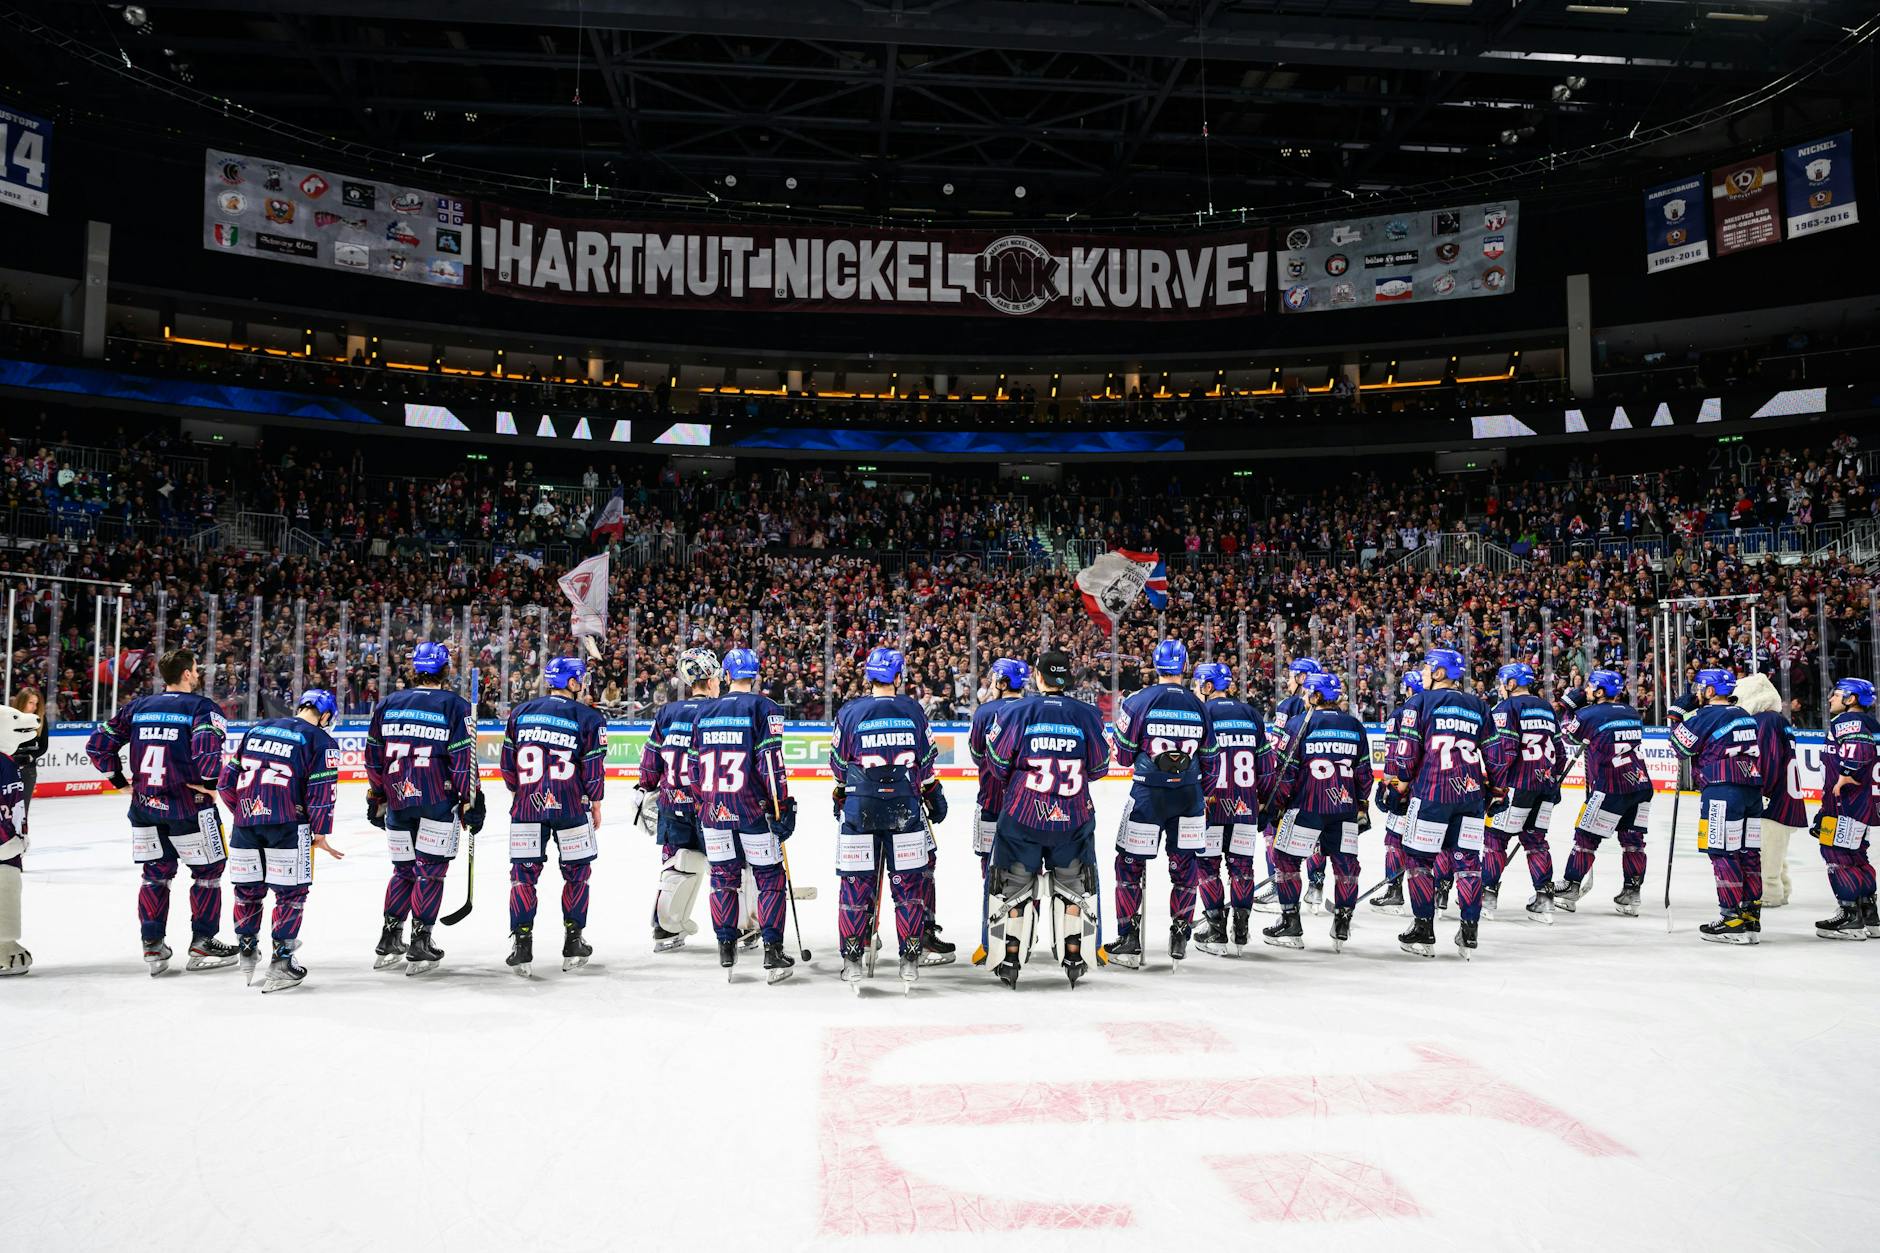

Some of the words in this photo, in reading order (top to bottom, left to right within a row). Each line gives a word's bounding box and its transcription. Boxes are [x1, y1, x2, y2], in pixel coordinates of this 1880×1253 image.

[1798, 140, 1837, 158] NICKEL
[498, 218, 753, 297] HARTMUT
[774, 238, 959, 302] NICKEL
[975, 251, 1060, 302] HNK
[1072, 243, 1247, 308] KURVE
[1706, 444, 1752, 471] 210
[385, 710, 415, 720] EISBÄREN
[420, 712, 445, 722] STROM
[138, 726, 180, 742] ELLIS
[518, 726, 578, 750] PFÖDERL
[663, 733, 691, 747] NCIC
[702, 731, 743, 745] REGIN
[861, 732, 916, 749] MAUER
[1147, 723, 1204, 739] GRENIER
[246, 737, 294, 758] CLARK
[1030, 737, 1077, 753] QUAPP
[36, 753, 61, 767] alt.
[140, 745, 167, 787] 4
[517, 745, 576, 785] 93
[700, 750, 746, 793] 13
[1216, 750, 1256, 789] 18
[1646, 763, 1678, 776] ership
[1026, 758, 1083, 797] 33
[1580, 794, 1599, 827] CONTIPARK
[205, 811, 224, 858] CONTIPARK
[1709, 803, 1718, 845] CONTIPARK
[1836, 816, 1846, 844] CONTIP
